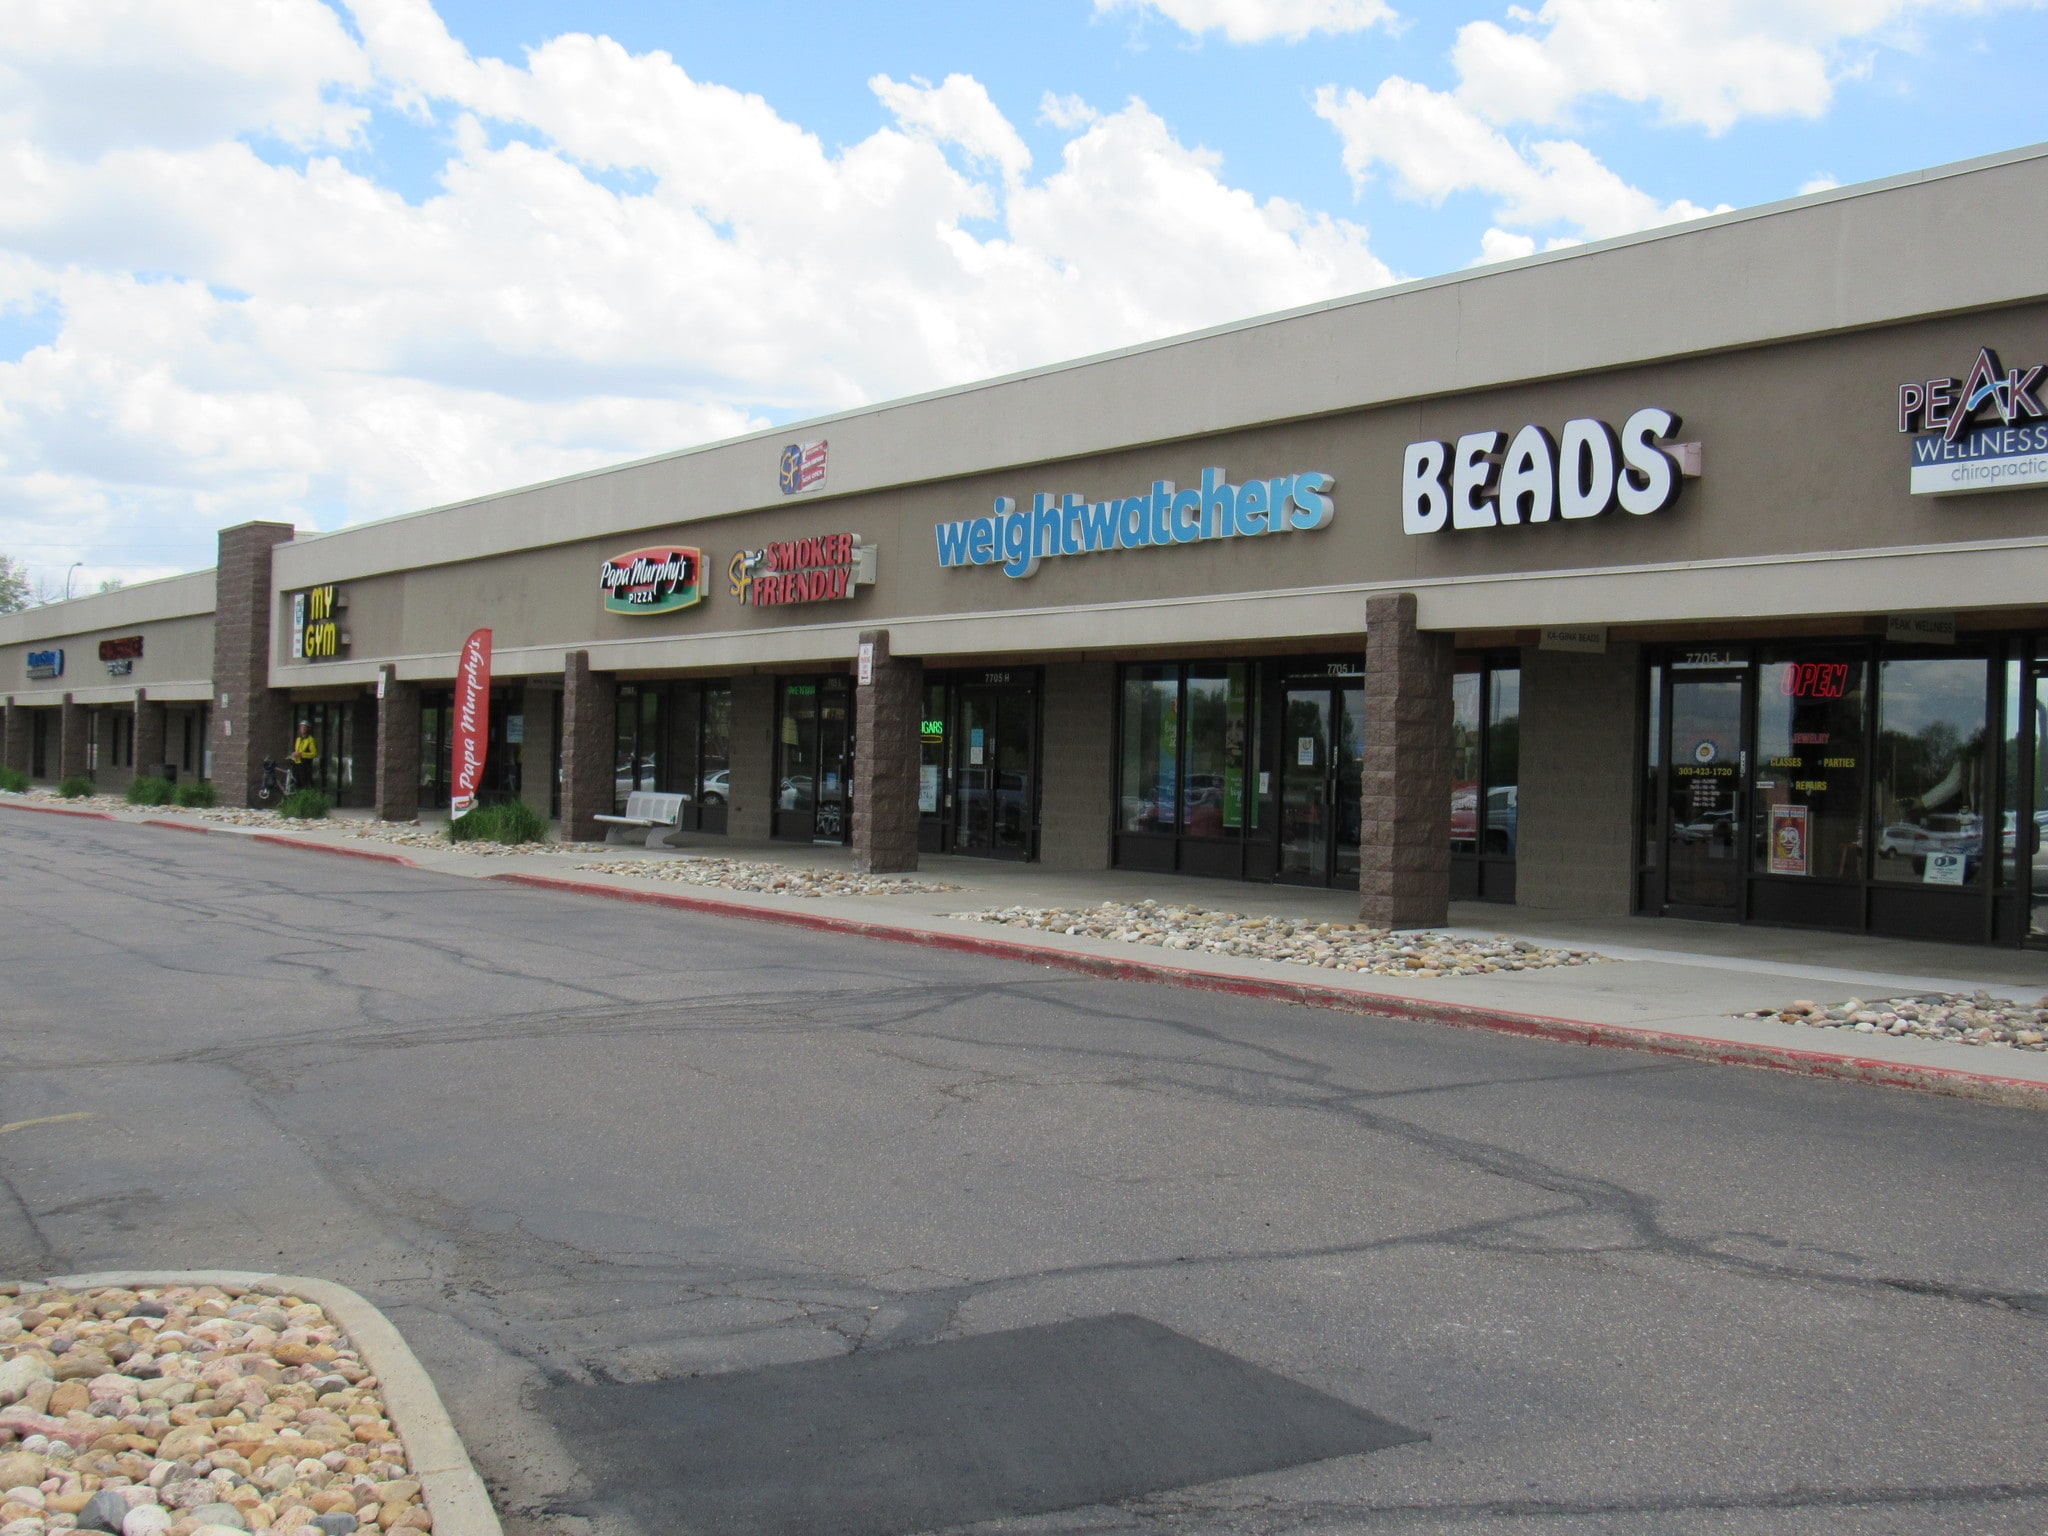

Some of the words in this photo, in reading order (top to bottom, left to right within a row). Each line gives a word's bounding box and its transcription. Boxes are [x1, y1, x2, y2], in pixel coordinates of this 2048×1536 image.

[1899, 347, 2045, 441] PEAK
[1915, 425, 2048, 462] WELLNESS
[1401, 406, 1678, 536] BEADS
[1951, 457, 2048, 482] chiropractic
[935, 467, 1332, 579] weightwatchers
[767, 533, 853, 573] SMOKER
[600, 561, 631, 599] Papa
[630, 551, 687, 596] Murphy's
[752, 567, 852, 606] FRIENDLY
[311, 585, 333, 620] MY
[629, 591, 653, 604] PIZZA
[305, 623, 335, 656] GYM
[1327, 664, 1348, 674] 7705
[1686, 653, 1718, 665] 7705
[461, 639, 484, 733] Murphy's
[985, 673, 1003, 683] 7705
[1779, 663, 1848, 697] OPEN
[921, 720, 943, 734] IGARS
[459, 740, 481, 790] Papa
[1678, 767, 1732, 776] 303-423-1720
[1770, 757, 1802, 767] CLASSES
[1824, 758, 1855, 768] PARTIES
[1796, 781, 1827, 791] REPAIRS
